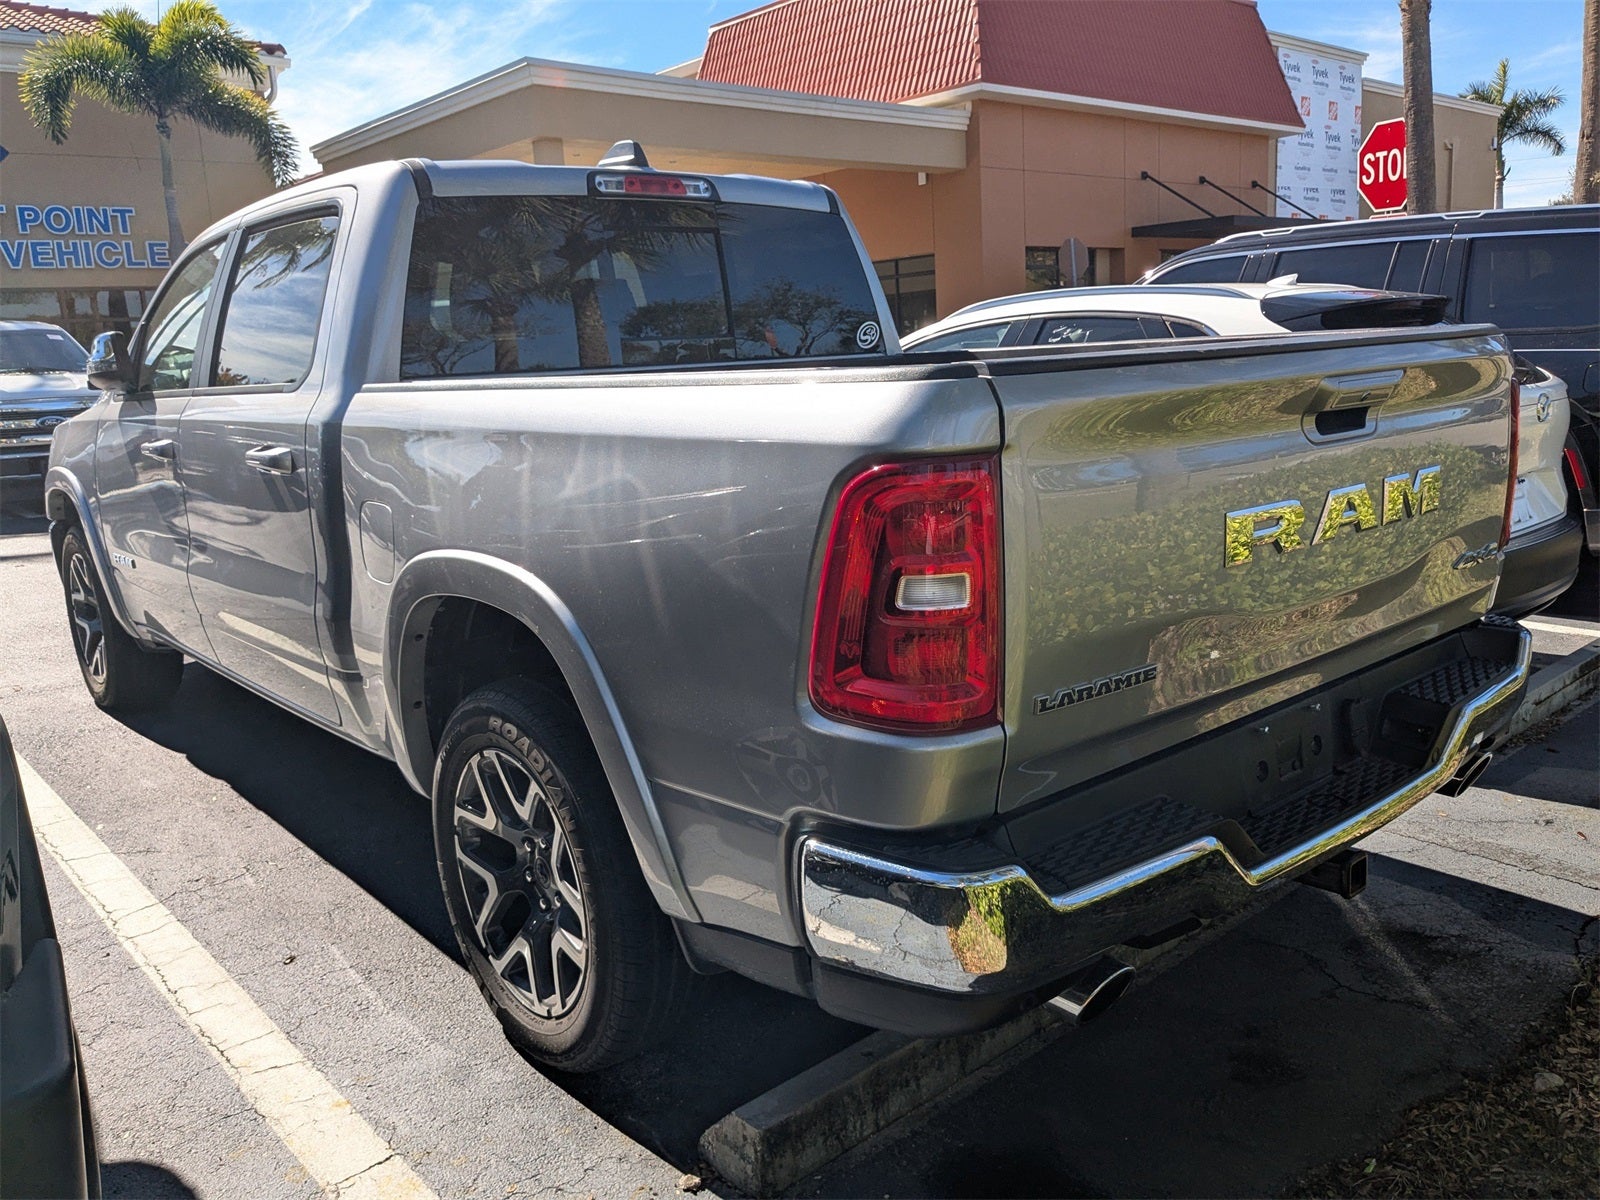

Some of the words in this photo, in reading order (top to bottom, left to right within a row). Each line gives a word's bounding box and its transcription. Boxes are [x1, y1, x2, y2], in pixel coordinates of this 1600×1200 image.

[1283, 60, 1301, 74] Tyvek
[1312, 66, 1329, 79] Tyvek
[1339, 72, 1355, 84] Tyvek
[1324, 131, 1341, 144] Tyvek
[16, 204, 135, 235] POINT
[0, 240, 172, 269] VEHICLE
[1225, 465, 1441, 567] RAM
[1034, 664, 1158, 715] LARAMIE
